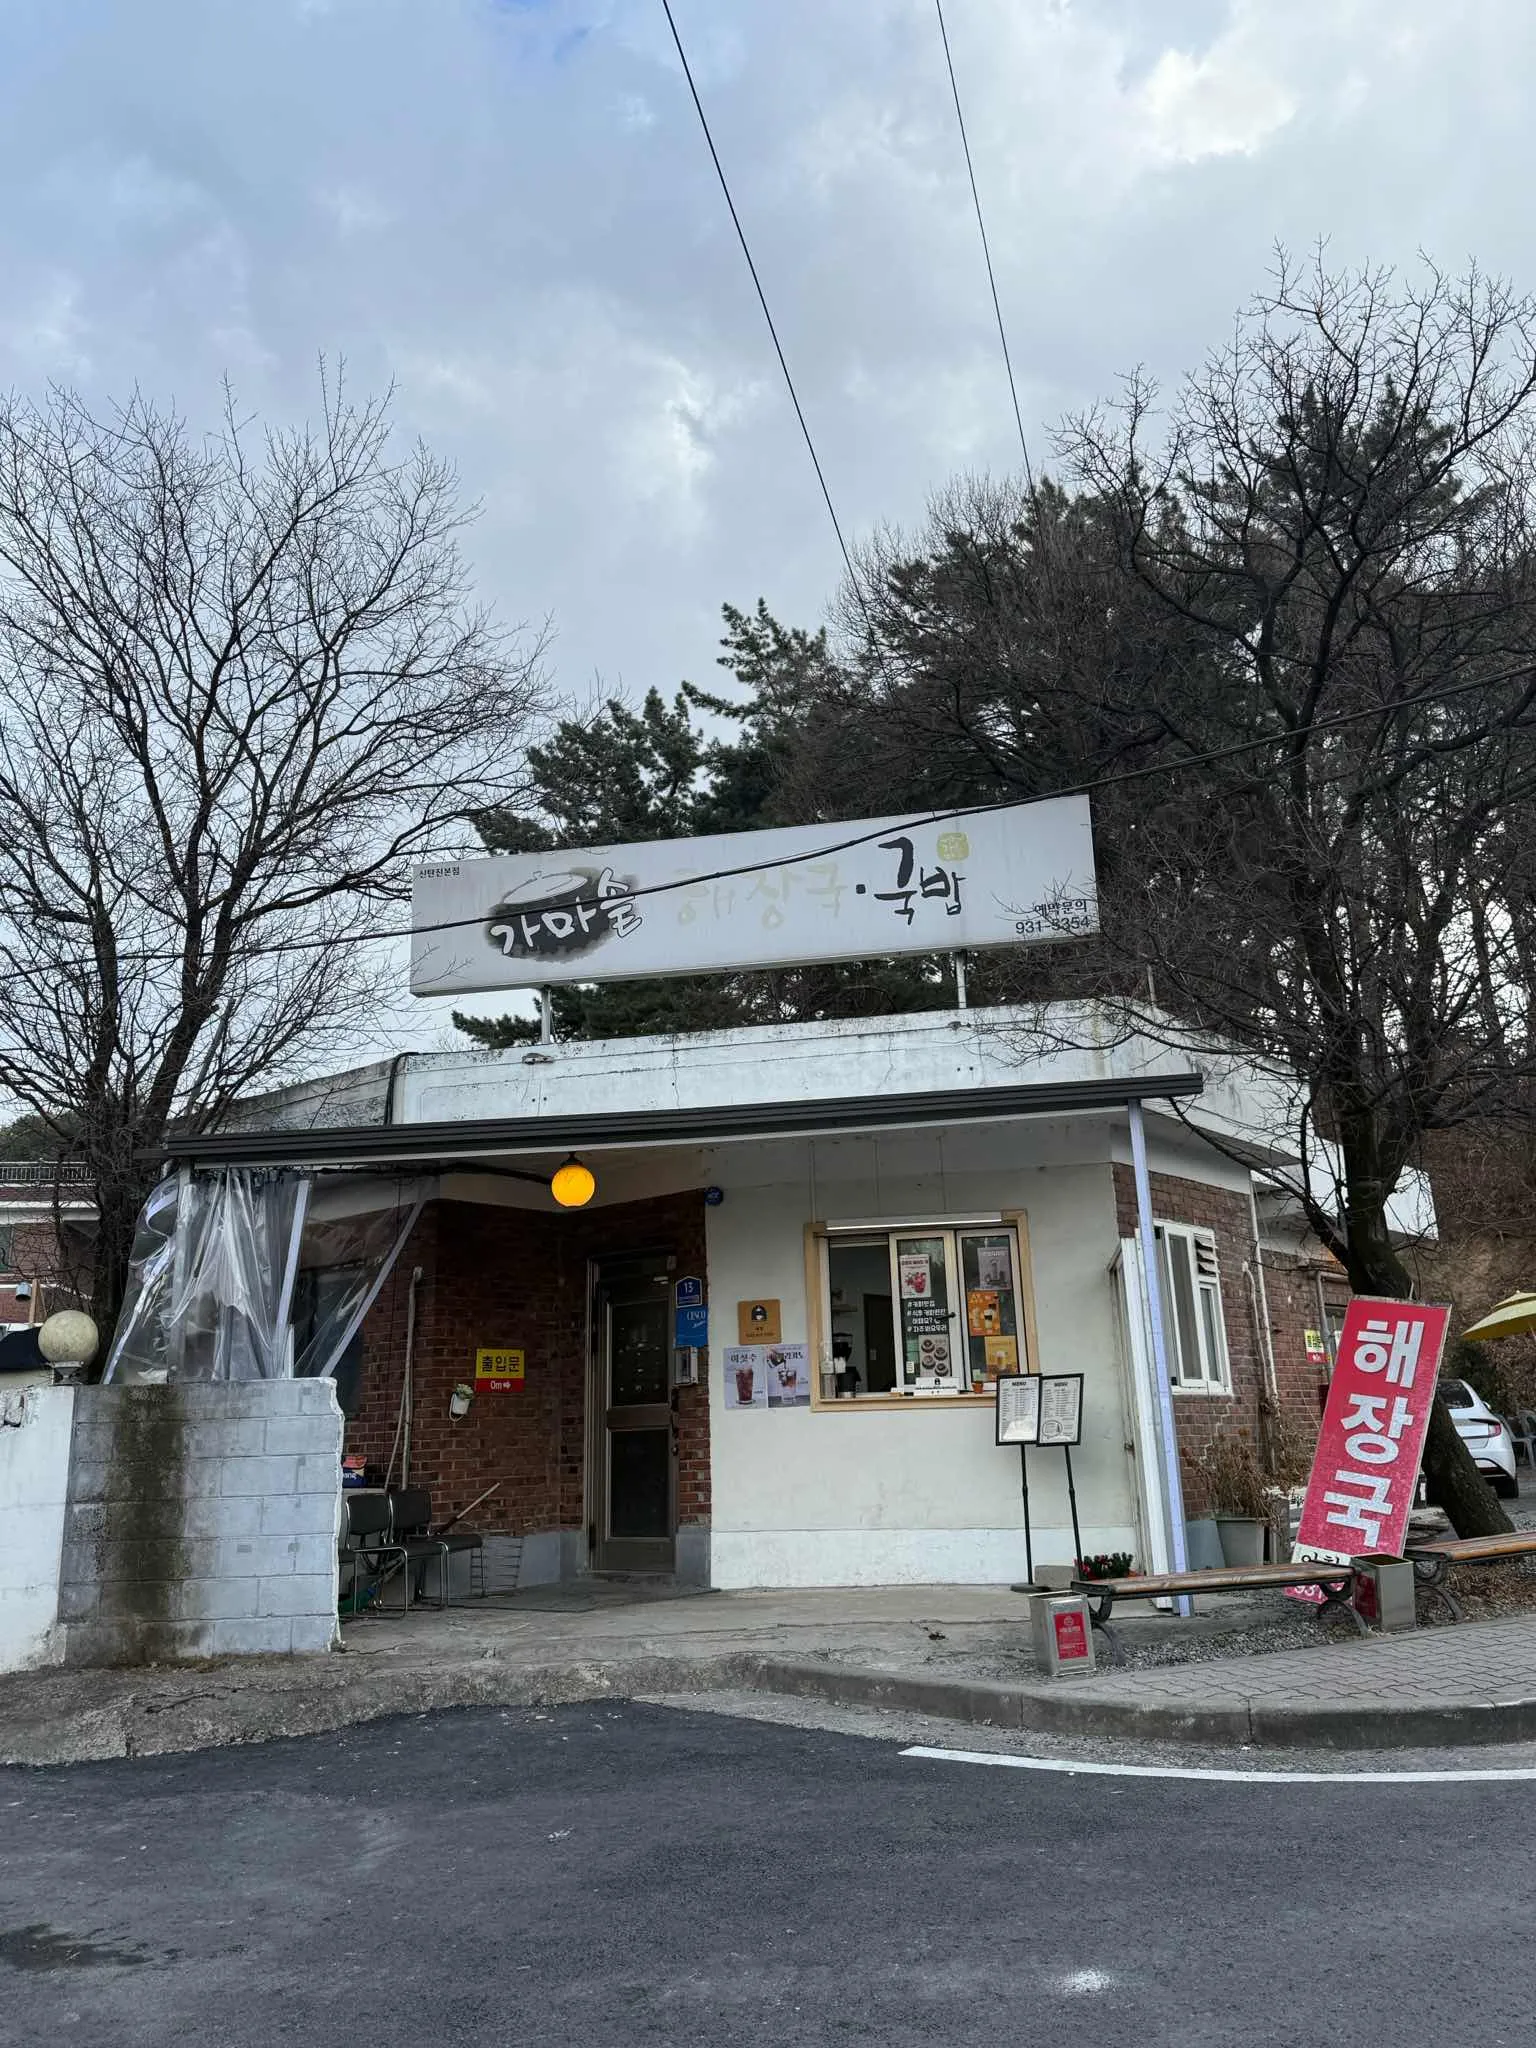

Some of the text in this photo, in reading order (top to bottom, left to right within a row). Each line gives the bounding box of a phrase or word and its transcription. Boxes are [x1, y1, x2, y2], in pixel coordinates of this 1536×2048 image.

[419, 866, 460, 879] 신탄진본점
[490, 867, 643, 955] 가마솥
[482, 1355, 520, 1373] 출입문
[1323, 1320, 1425, 1548] 해장국
